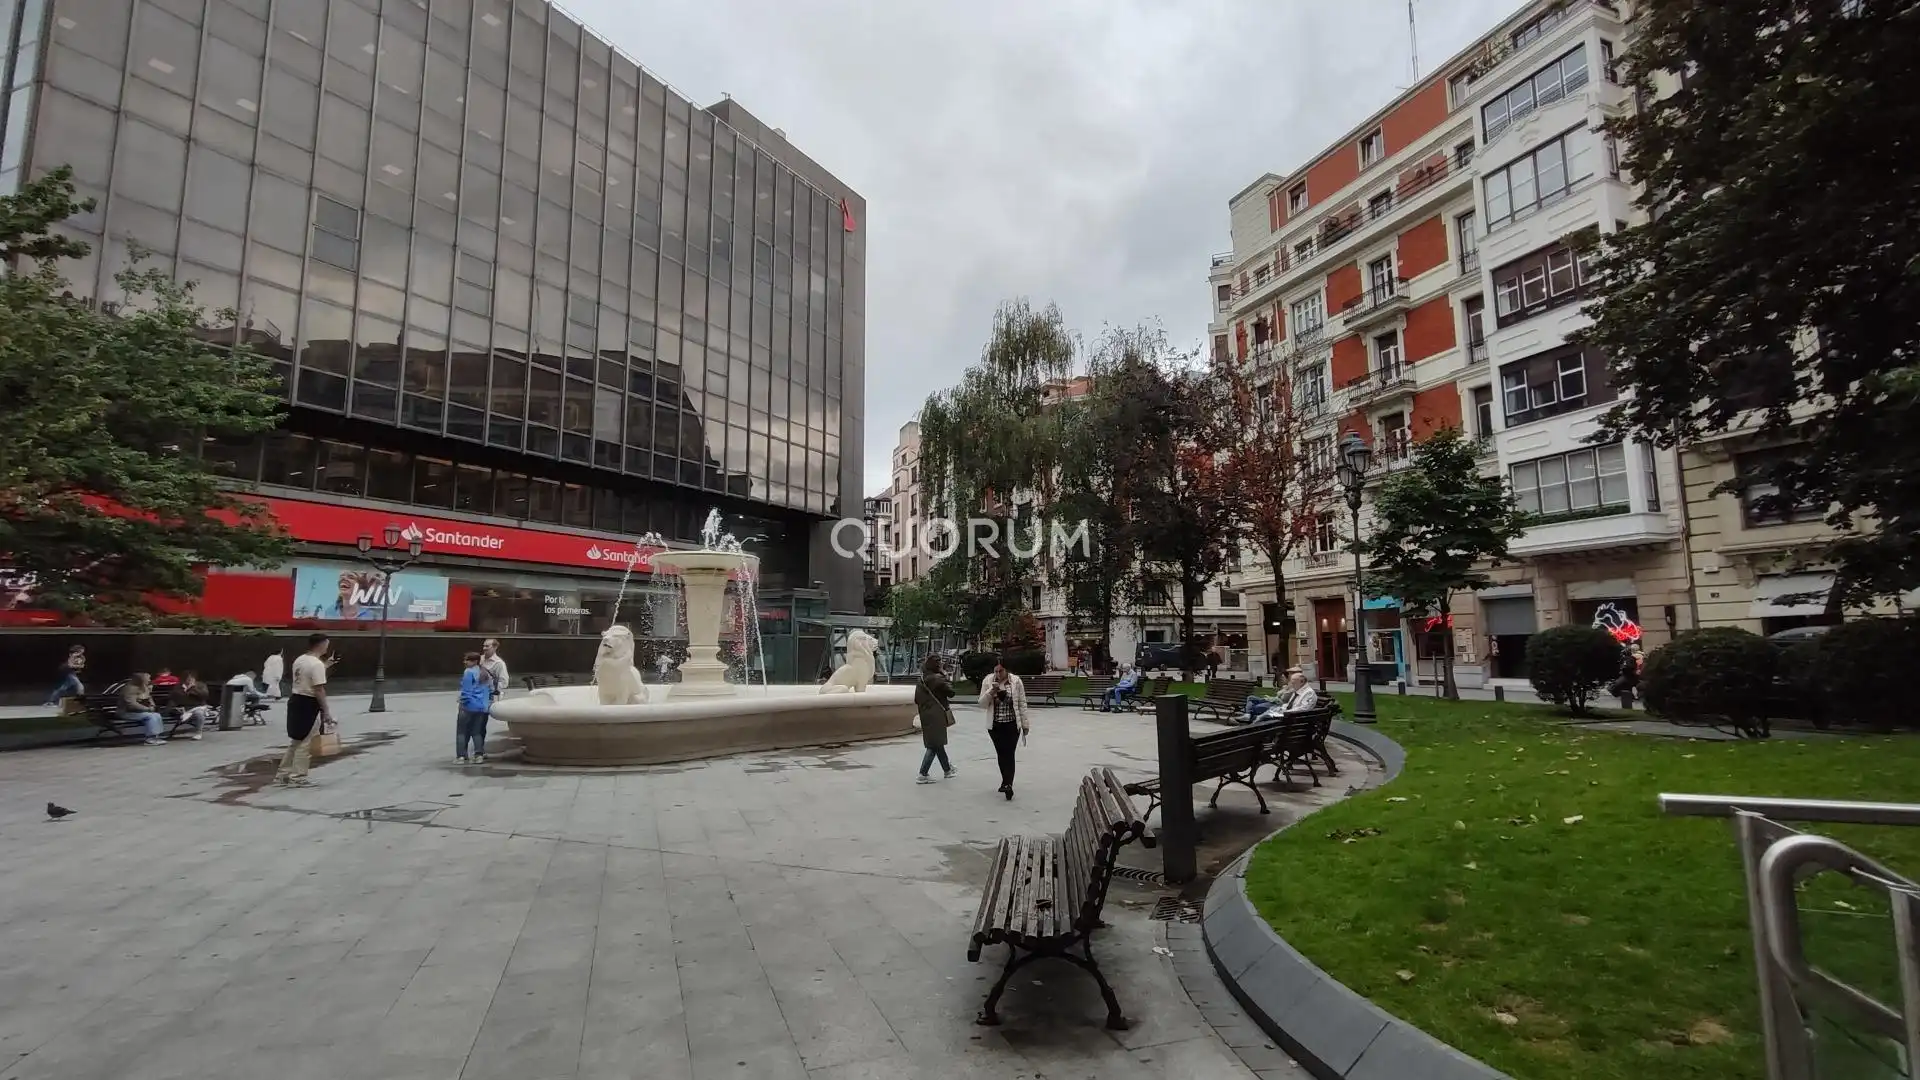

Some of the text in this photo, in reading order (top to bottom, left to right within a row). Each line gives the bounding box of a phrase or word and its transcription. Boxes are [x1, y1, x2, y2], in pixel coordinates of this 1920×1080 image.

[425, 527, 505, 550] Santander
[602, 548, 649, 565] Santand
[544, 594, 558, 604] Por
[544, 604, 556, 614] los
